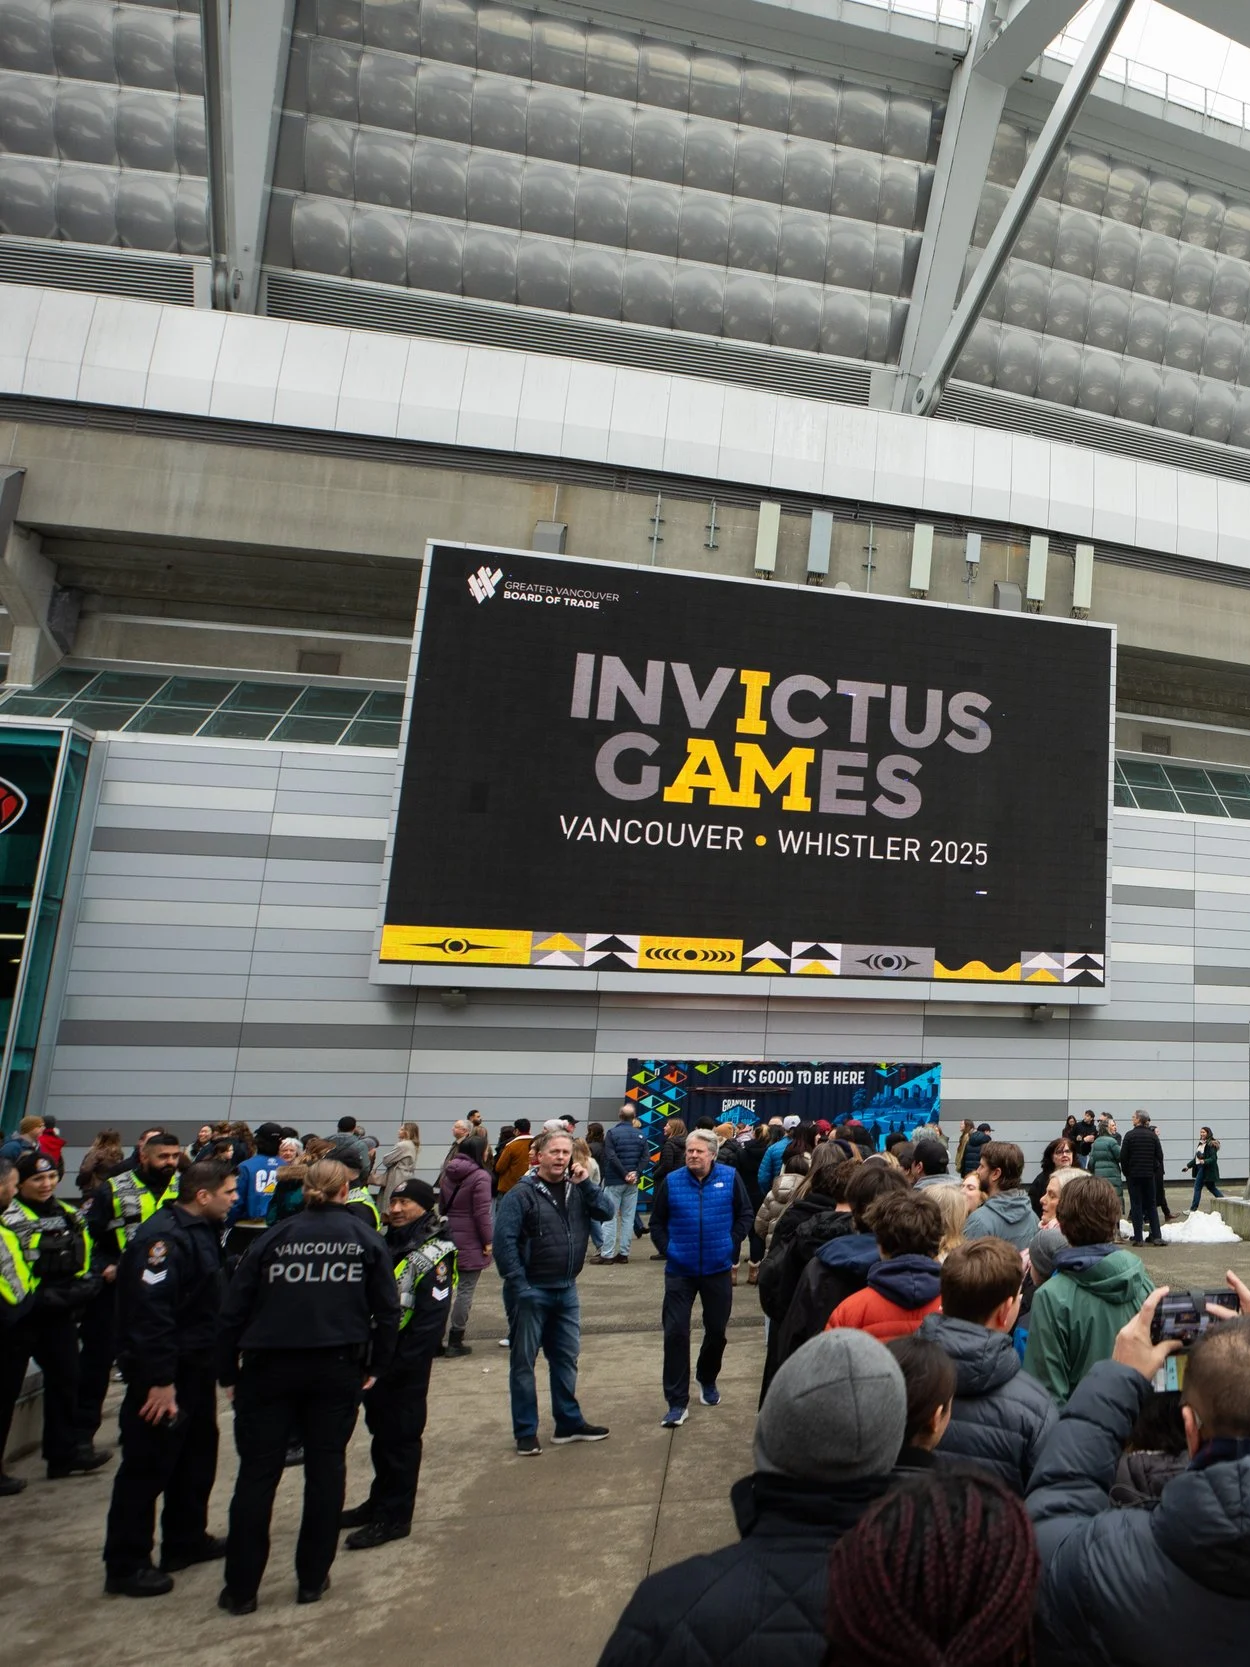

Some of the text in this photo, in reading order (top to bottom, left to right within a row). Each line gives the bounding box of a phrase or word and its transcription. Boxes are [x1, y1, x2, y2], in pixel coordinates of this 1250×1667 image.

[503, 590, 600, 610] BOARD OF TRADE
[504, 581, 620, 602] GREATER VANCOUVER
[570, 652, 993, 754] INVICTUS
[594, 731, 923, 819] GAMES
[559, 814, 988, 866] VANCOUVER WHISTLER 2025
[759, 1070, 794, 1084] GOOD
[796, 1070, 811, 1085] TO
[814, 1070, 830, 1085] BE
[833, 1071, 865, 1085] HERE
[722, 1099, 756, 1113] GRANVILLE
[256, 1169, 278, 1193] CA
[268, 1262, 364, 1284] POLICE
